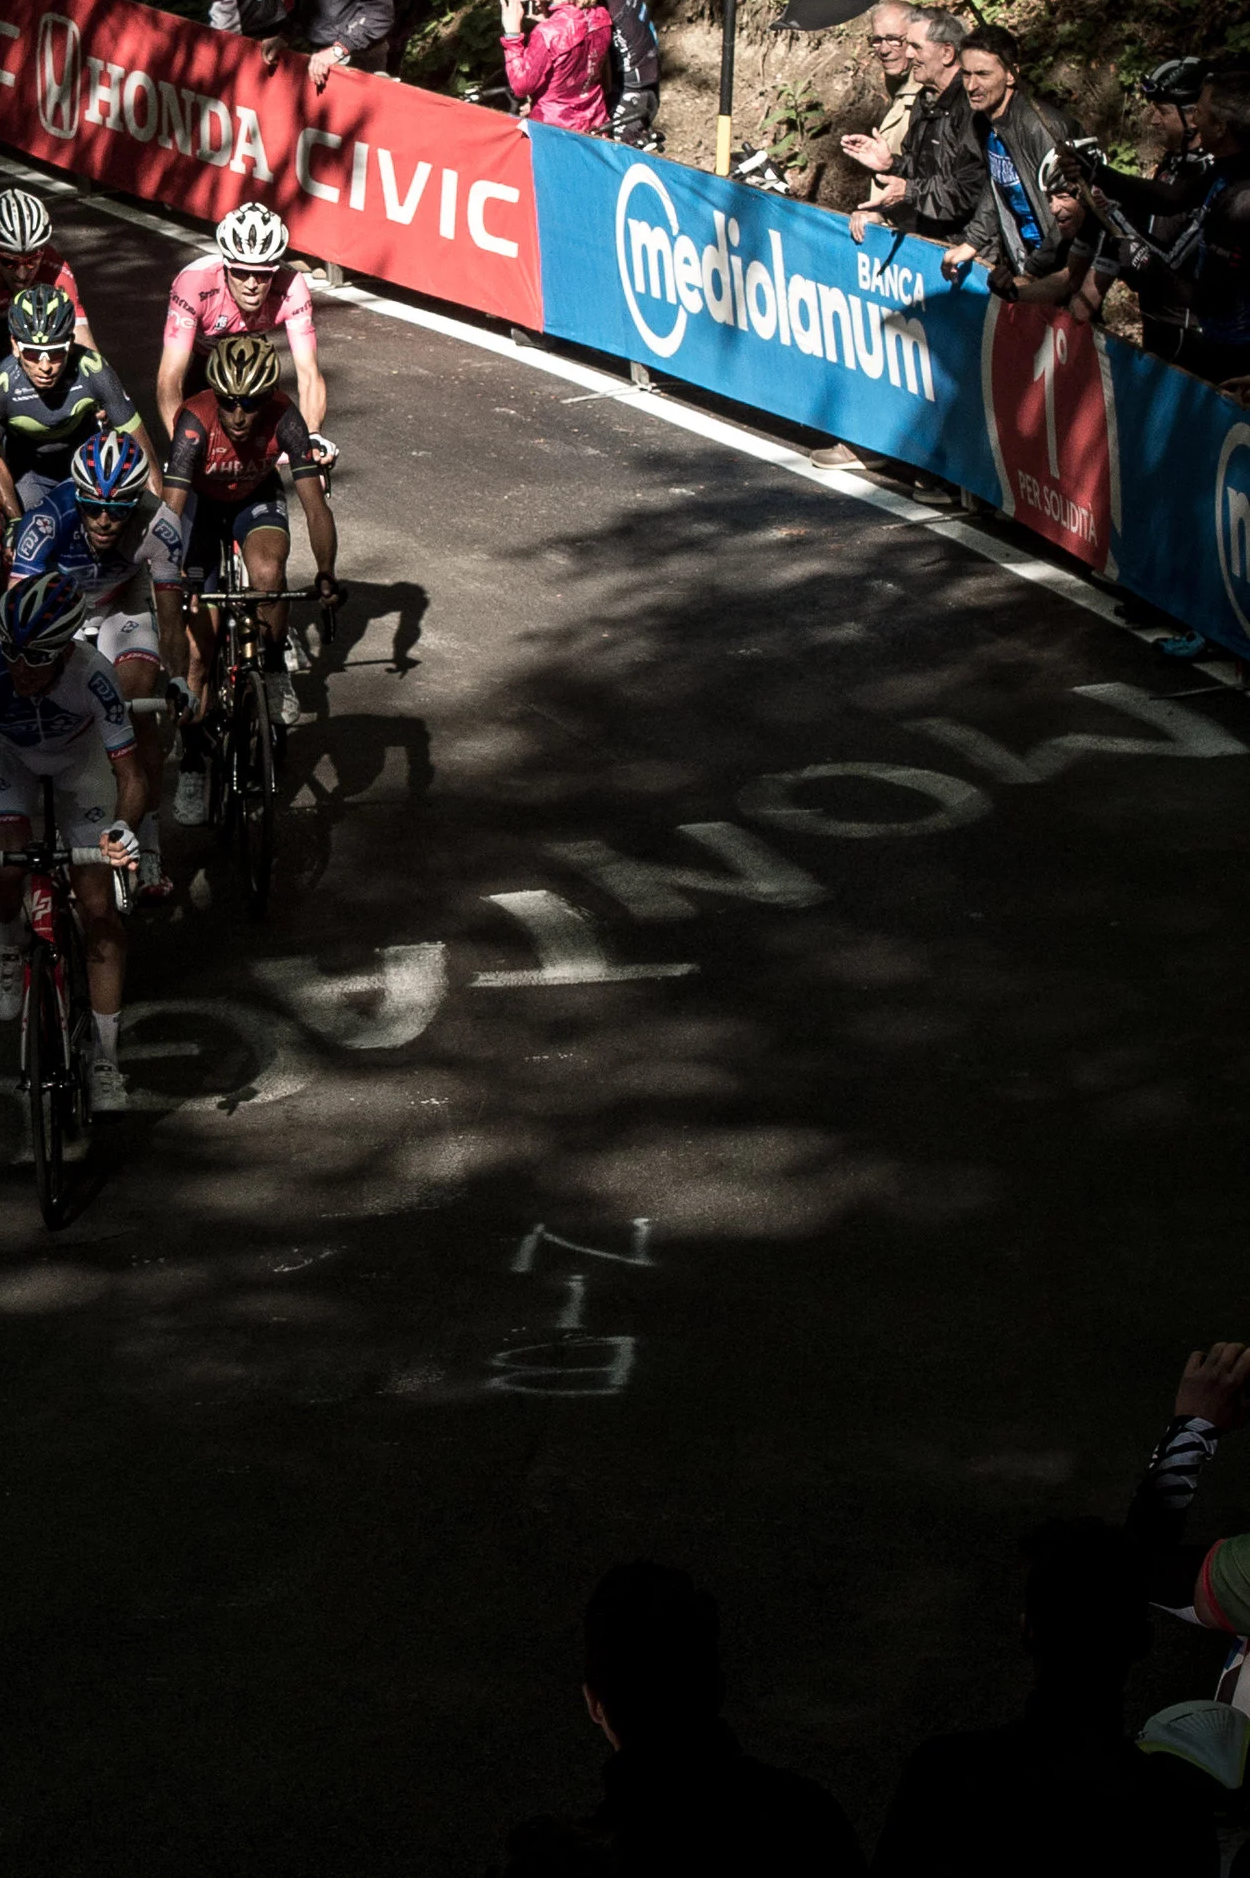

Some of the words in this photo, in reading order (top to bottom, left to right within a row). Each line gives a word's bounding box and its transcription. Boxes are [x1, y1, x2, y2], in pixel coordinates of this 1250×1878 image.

[85, 56, 274, 183] HONDA
[296, 126, 520, 259] CIVIC
[628, 210, 935, 402] mediolanum
[857, 252, 926, 313] BANCA
[20, 530, 39, 557] FDJ
[154, 523, 179, 545] FDJ
[1017, 470, 1041, 508] PER
[1049, 485, 1099, 548] SOLIDITÀ
